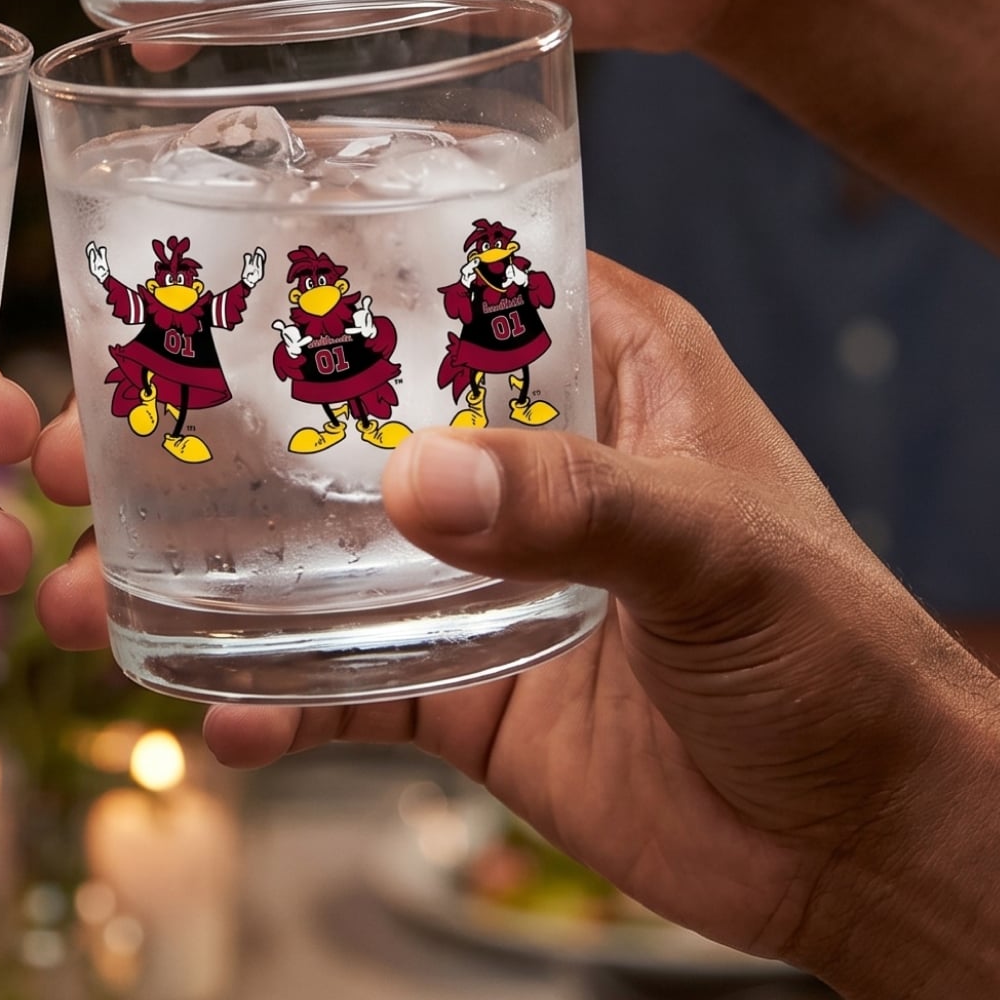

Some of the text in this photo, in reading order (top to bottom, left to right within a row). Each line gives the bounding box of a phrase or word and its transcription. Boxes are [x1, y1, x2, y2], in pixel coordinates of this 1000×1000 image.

[490, 311, 526, 341] 01
[164, 328, 195, 358] 01
[315, 346, 350, 375] 01
